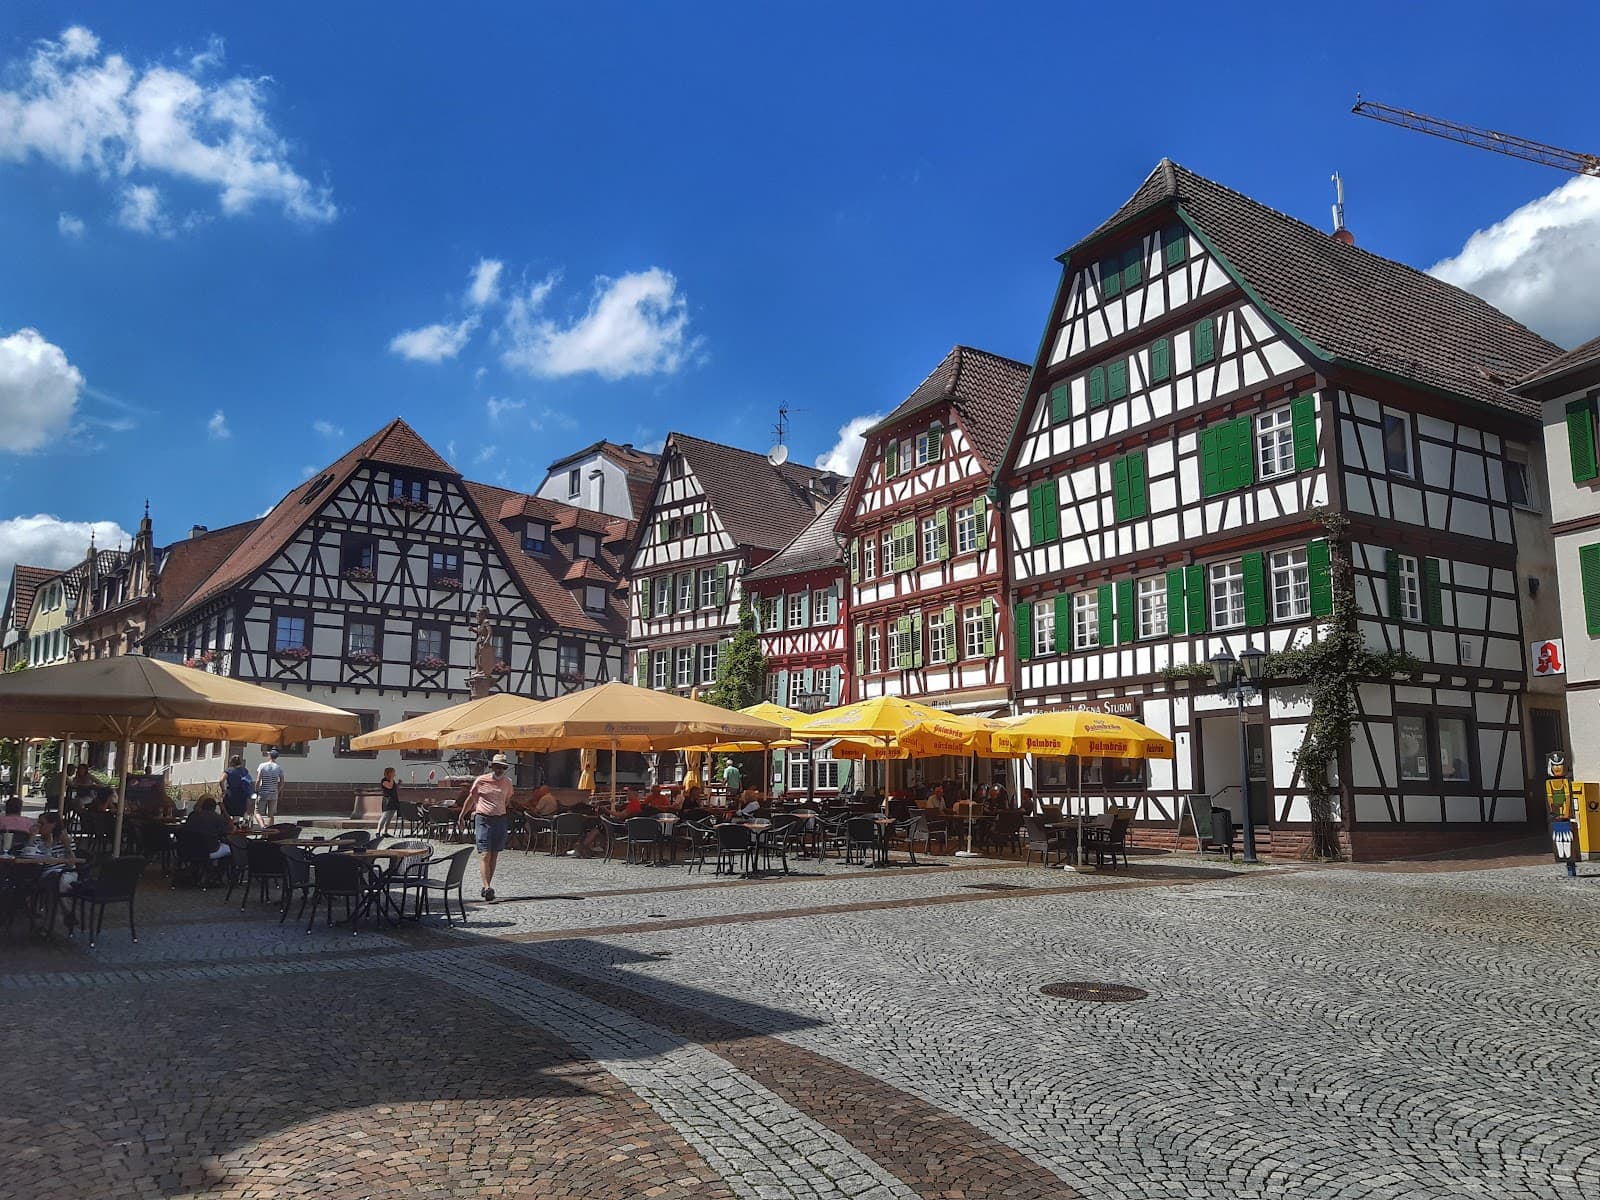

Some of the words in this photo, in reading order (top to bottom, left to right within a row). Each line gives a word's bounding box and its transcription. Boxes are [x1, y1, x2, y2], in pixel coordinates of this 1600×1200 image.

[1536, 641, 1561, 673] A
[1104, 701, 1132, 714] STURM
[1089, 741, 1128, 752] Palmbräu
